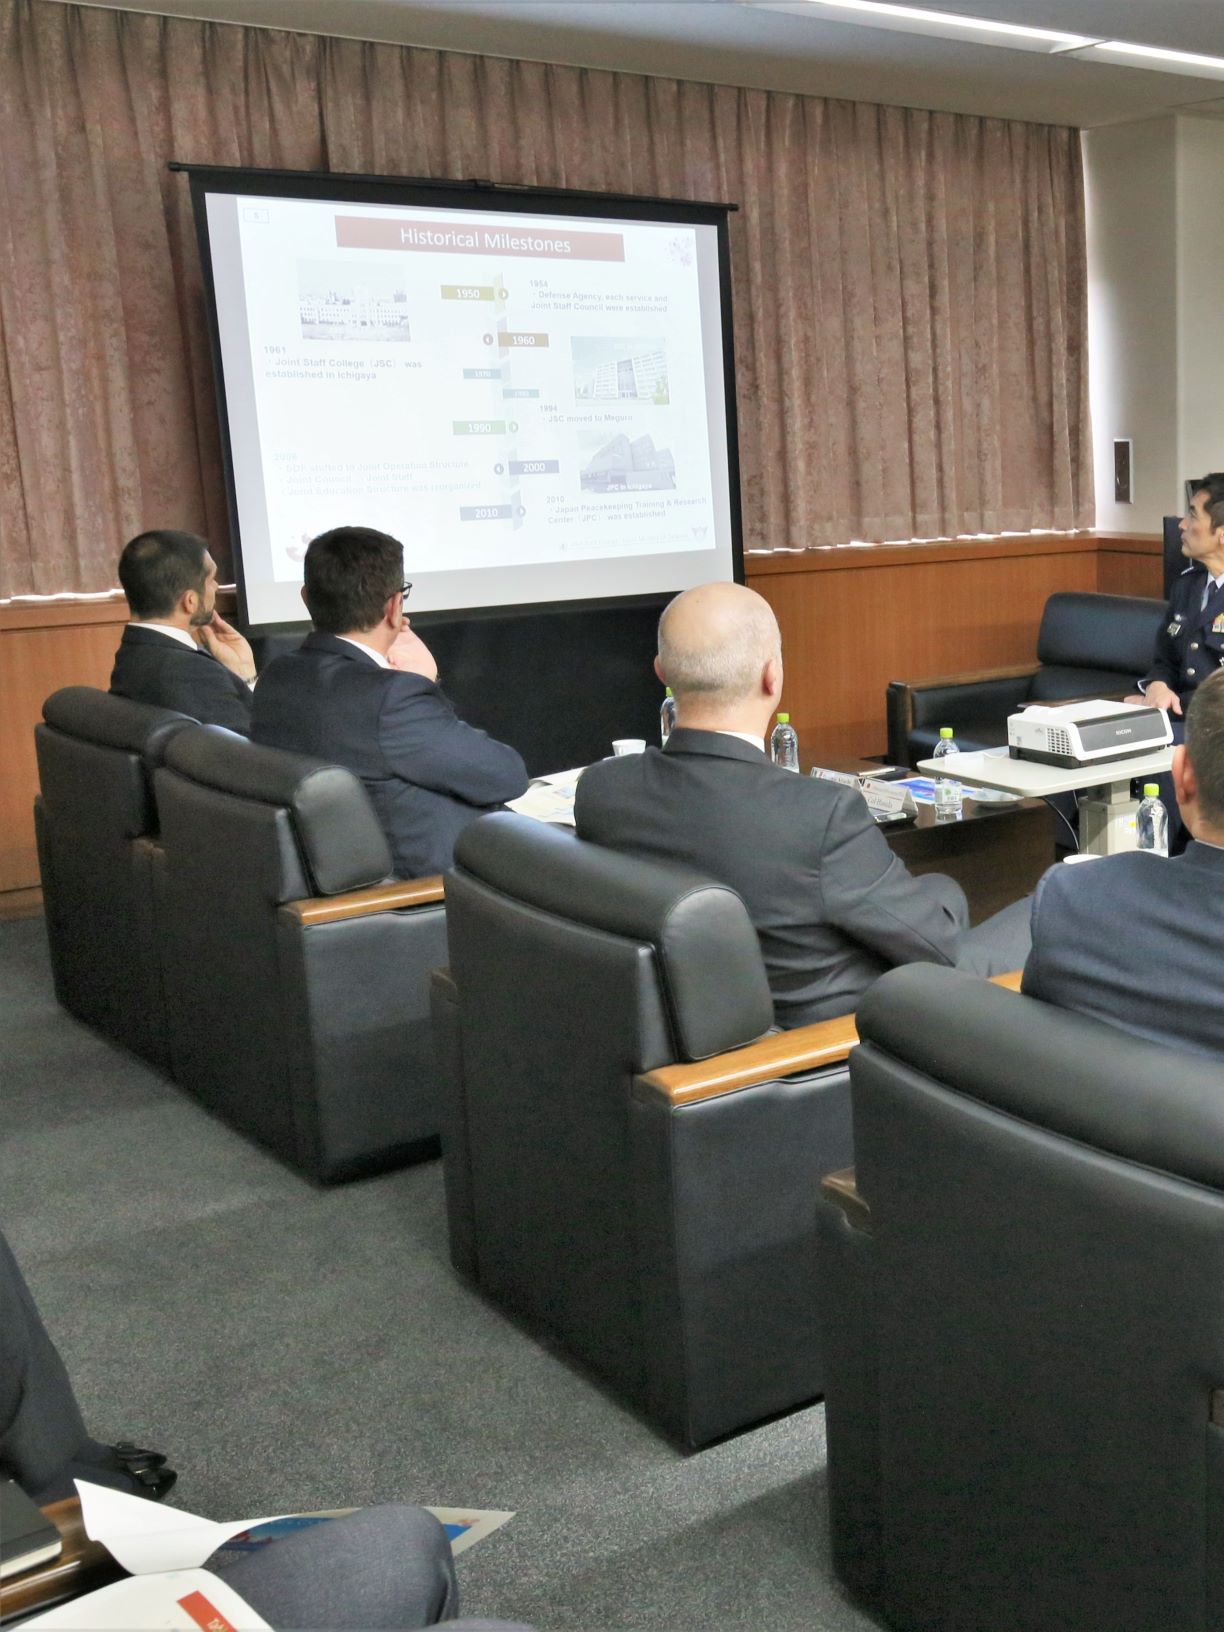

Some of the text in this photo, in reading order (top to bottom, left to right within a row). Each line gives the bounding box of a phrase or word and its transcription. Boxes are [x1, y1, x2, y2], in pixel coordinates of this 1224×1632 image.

[400, 228, 572, 253] Historical Milestones
[529, 279, 549, 288] 1954
[456, 288, 480, 299] 1950
[538, 290, 571, 299] Defense
[605, 293, 624, 301] each
[626, 294, 652, 302] service
[654, 295, 668, 303] and
[531, 302, 551, 310] Joint
[553, 302, 572, 311] Staff
[573, 302, 603, 311] Council
[625, 304, 668, 313] established
[512, 335, 535, 346] 1960
[264, 346, 286, 354] 1961
[275, 358, 300, 367] Joint
[303, 358, 326, 367] Staff
[328, 359, 365, 369] College
[404, 361, 422, 369] was
[265, 370, 377, 381] established in Ichigaya
[567, 414, 592, 423] moved
[468, 422, 491, 433] 1990
[523, 462, 546, 473] 2000
[546, 496, 565, 504] 2010
[555, 506, 579, 514] Japan
[581, 503, 633, 513] Peacekeeping
[635, 500, 664, 509] Training
[475, 508, 498, 518] 2010
[548, 516, 573, 524] Center
[608, 513, 622, 521] was
[624, 510, 666, 520] established
